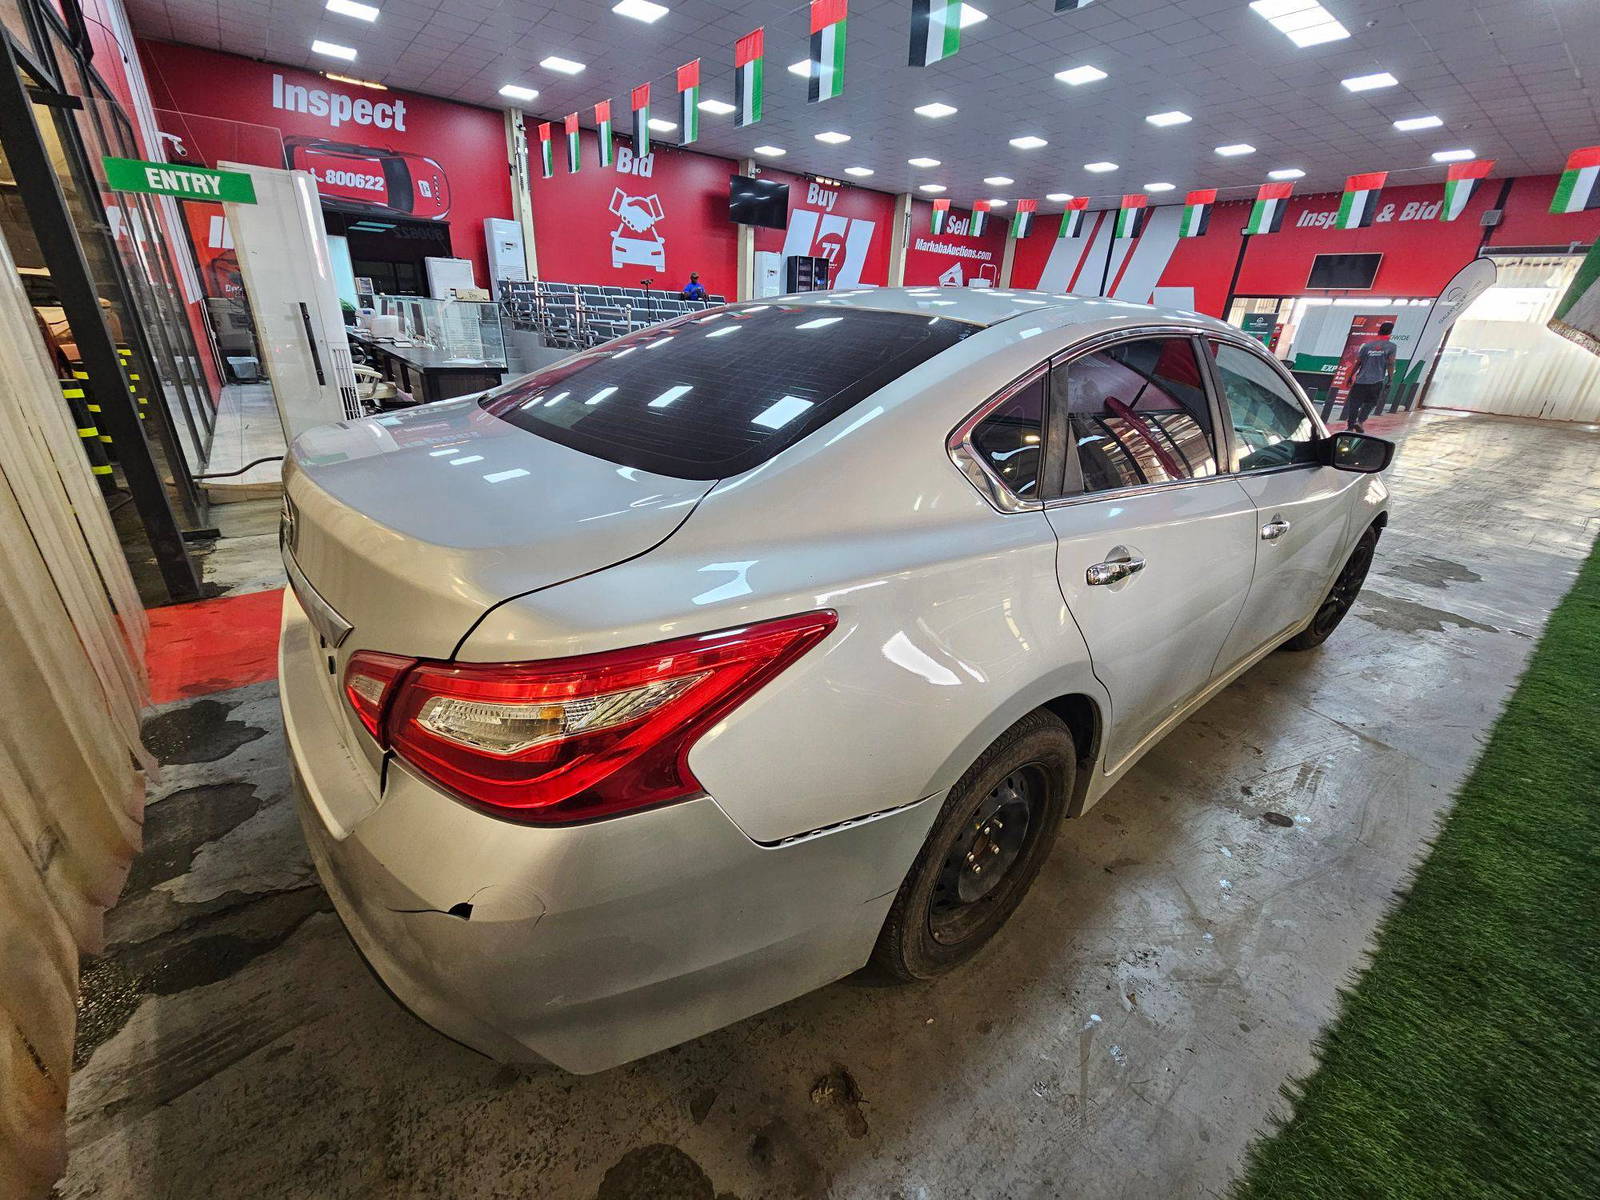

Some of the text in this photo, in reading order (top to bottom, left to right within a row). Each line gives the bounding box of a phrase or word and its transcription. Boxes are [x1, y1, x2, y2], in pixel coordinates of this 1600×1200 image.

[272, 73, 406, 132] Inspect
[616, 146, 654, 178] Bid
[144, 167, 221, 195] ENTRY
[325, 169, 385, 191] 800622
[806, 182, 838, 212] Buy
[1376, 203, 1396, 222] &
[1398, 200, 1444, 221] Bid
[946, 215, 970, 236] Sell
[822, 242, 841, 263] 77
[914, 238, 992, 261] MarhabaAuctions.com
